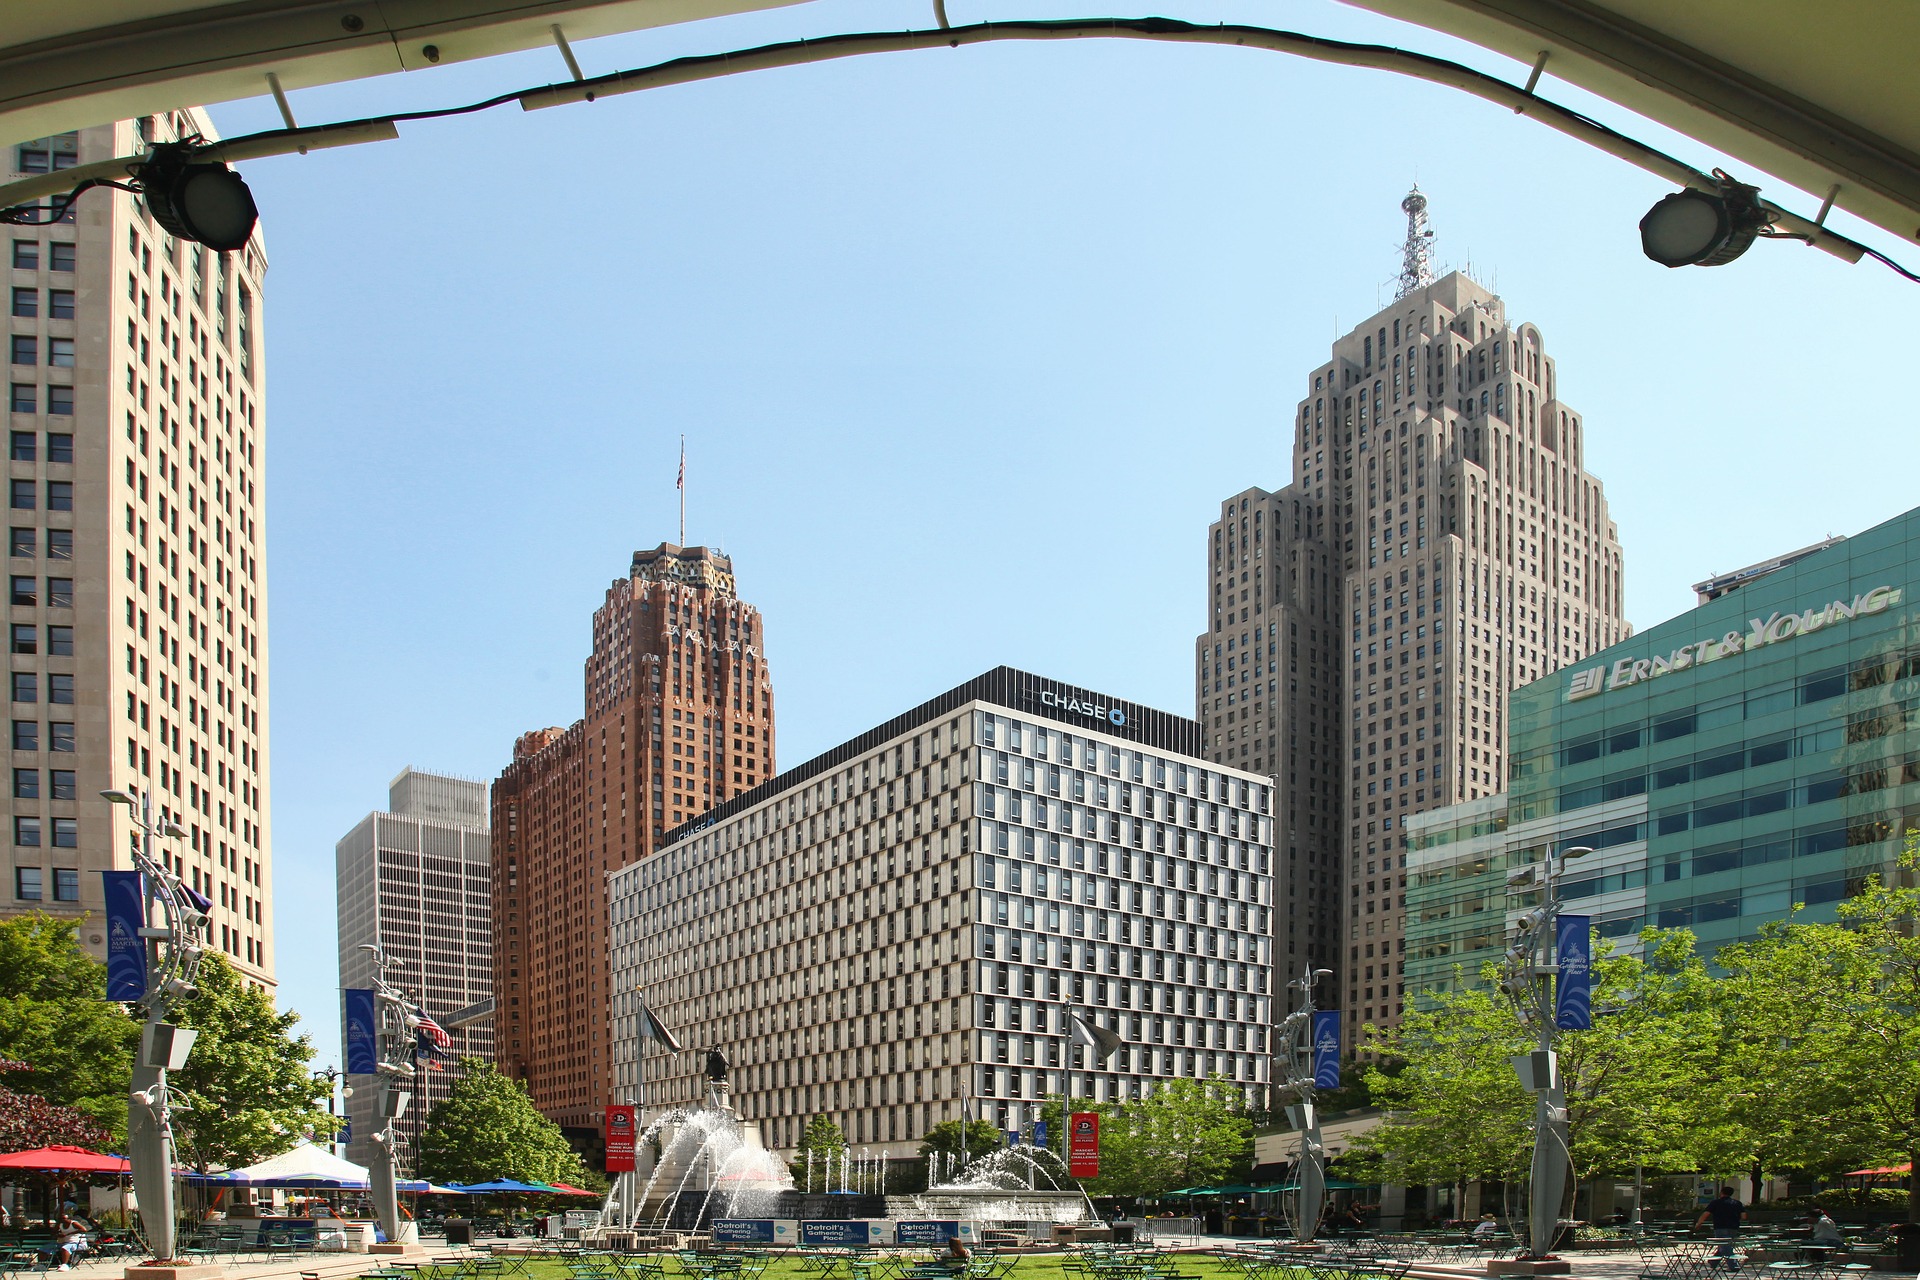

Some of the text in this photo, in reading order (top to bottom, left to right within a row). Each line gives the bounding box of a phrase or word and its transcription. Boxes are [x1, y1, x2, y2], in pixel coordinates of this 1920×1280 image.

[1609, 585, 1893, 690] ERNST & YOUNG
[1041, 691, 1106, 720] CHASE
[678, 822, 706, 841] CHASE
